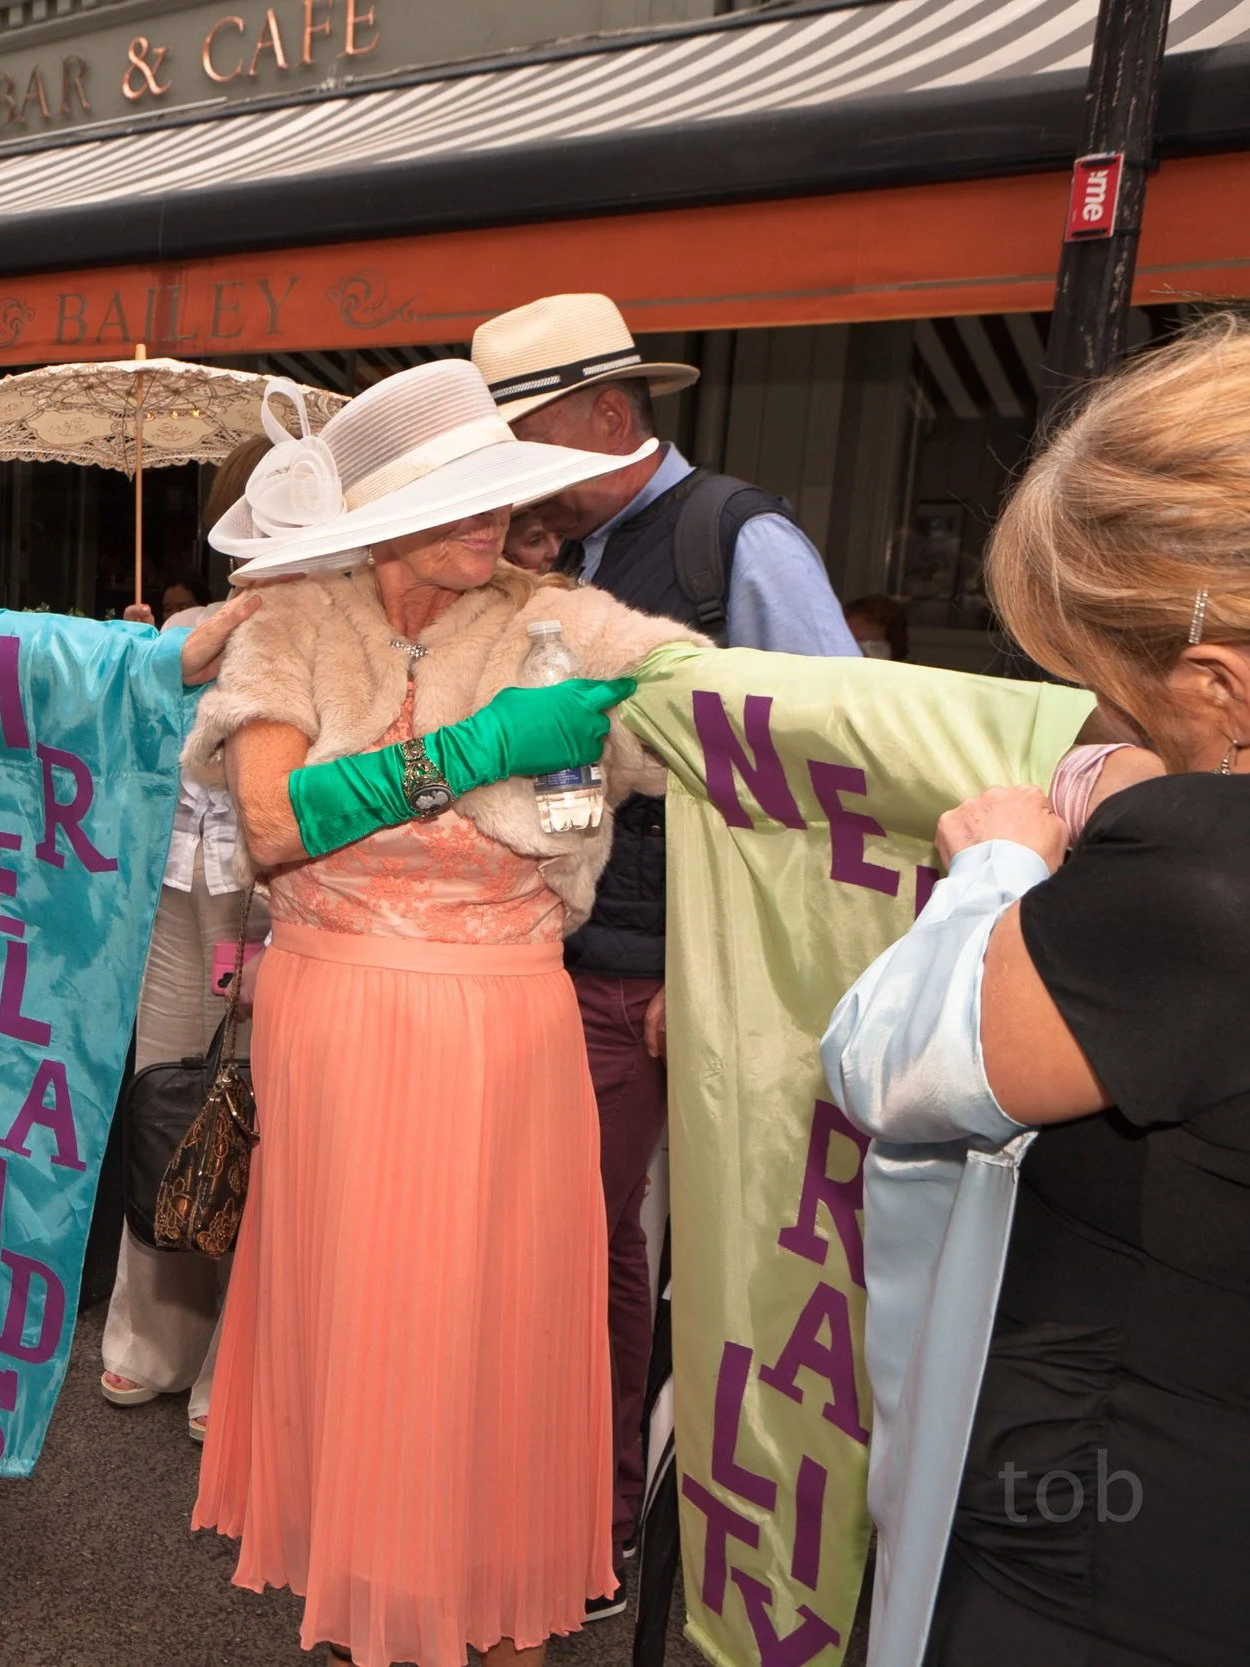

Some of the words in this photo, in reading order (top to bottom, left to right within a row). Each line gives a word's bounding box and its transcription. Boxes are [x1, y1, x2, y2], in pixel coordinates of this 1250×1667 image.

[121, 36, 172, 100] &
[201, 0, 380, 83] CAFE
[53, 273, 300, 347] BAILEY
[681, 689, 940, 1667] NERALITY
